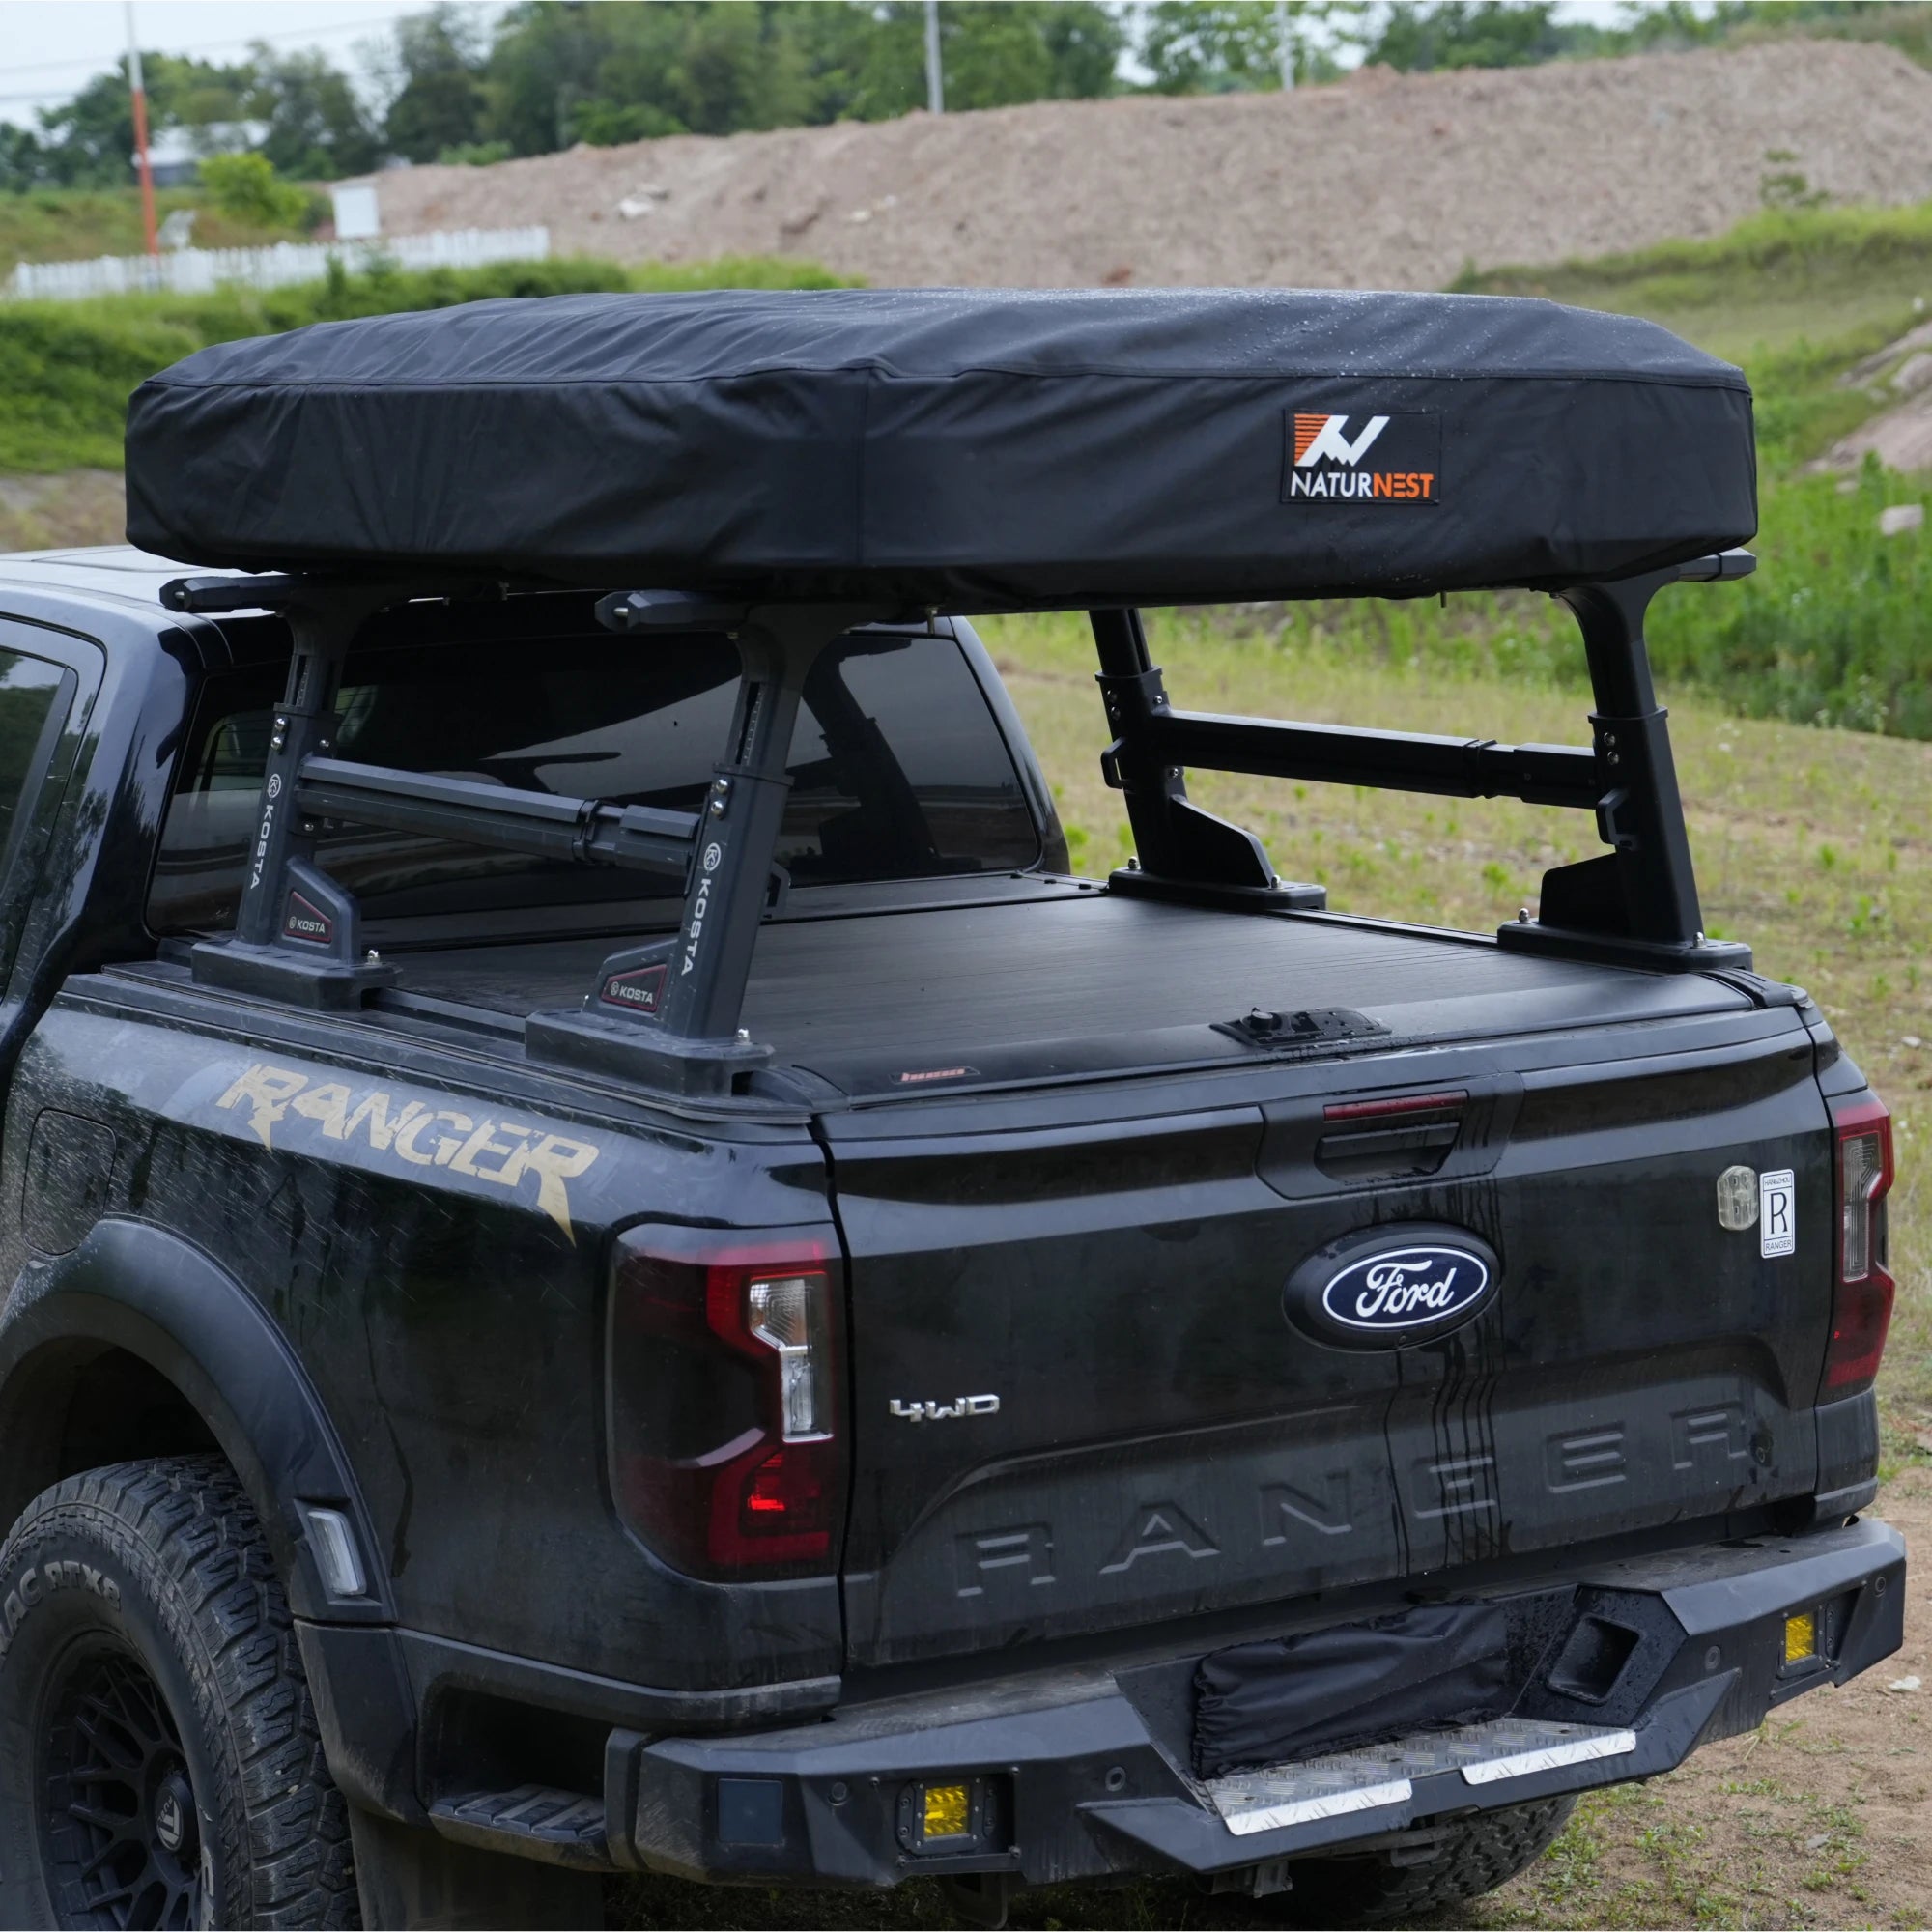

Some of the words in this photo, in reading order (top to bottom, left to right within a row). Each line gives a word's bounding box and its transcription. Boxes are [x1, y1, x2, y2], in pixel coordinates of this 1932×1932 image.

[1291, 470, 1434, 498] NATURNEST
[250, 804, 274, 890] KOSTA
[297, 919, 327, 934] KOSTA
[681, 878, 712, 976] KOSTA
[619, 986, 653, 1004] KOSTA
[215, 1063, 599, 1249] RANGER
[1770, 1192, 1788, 1234] R
[1765, 1239, 1792, 1252] RANGER
[1355, 1260, 1457, 1318] Ford
[890, 1394, 1000, 1422] 4WD
[955, 1403, 1748, 1598] RANGER
